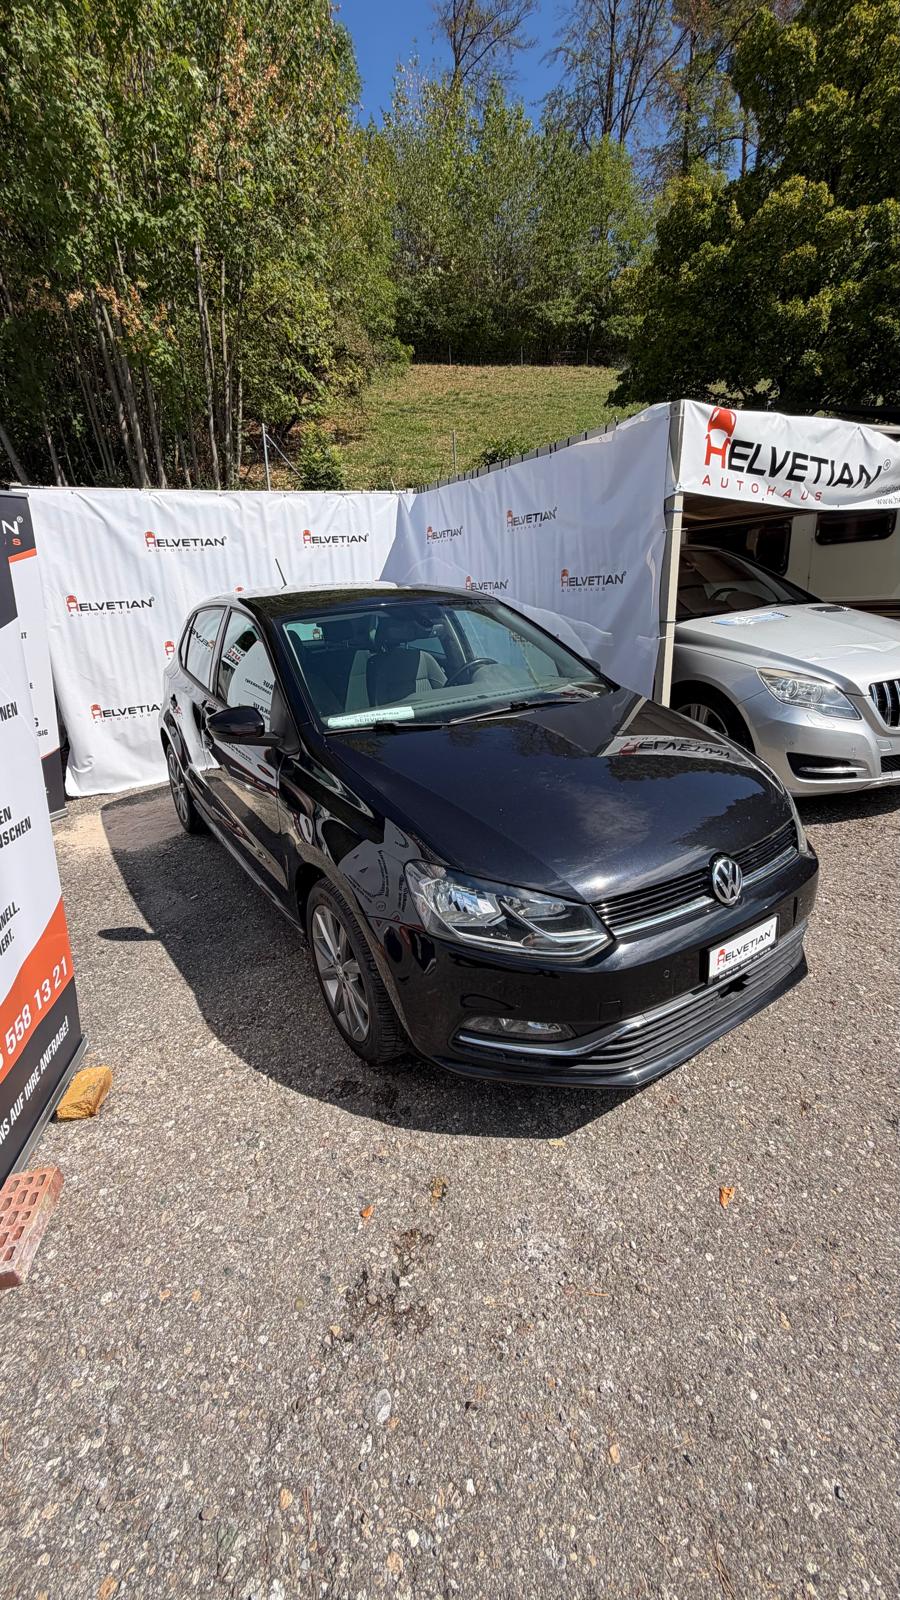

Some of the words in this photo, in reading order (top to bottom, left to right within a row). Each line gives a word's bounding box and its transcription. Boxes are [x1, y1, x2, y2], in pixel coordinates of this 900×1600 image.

[702, 475, 822, 501] AUTOHAUS
[90, 704, 162, 719] HELVETIA
[0, 902, 20, 931] NELL.
[5, 1004, 32, 1055] 558
[34, 979, 51, 1010] 13
[53, 956, 68, 989] 21
[10, 1092, 24, 1126] AUF
[24, 1065, 41, 1100] IHRE
[40, 1015, 70, 1074] ANFRAGE!
